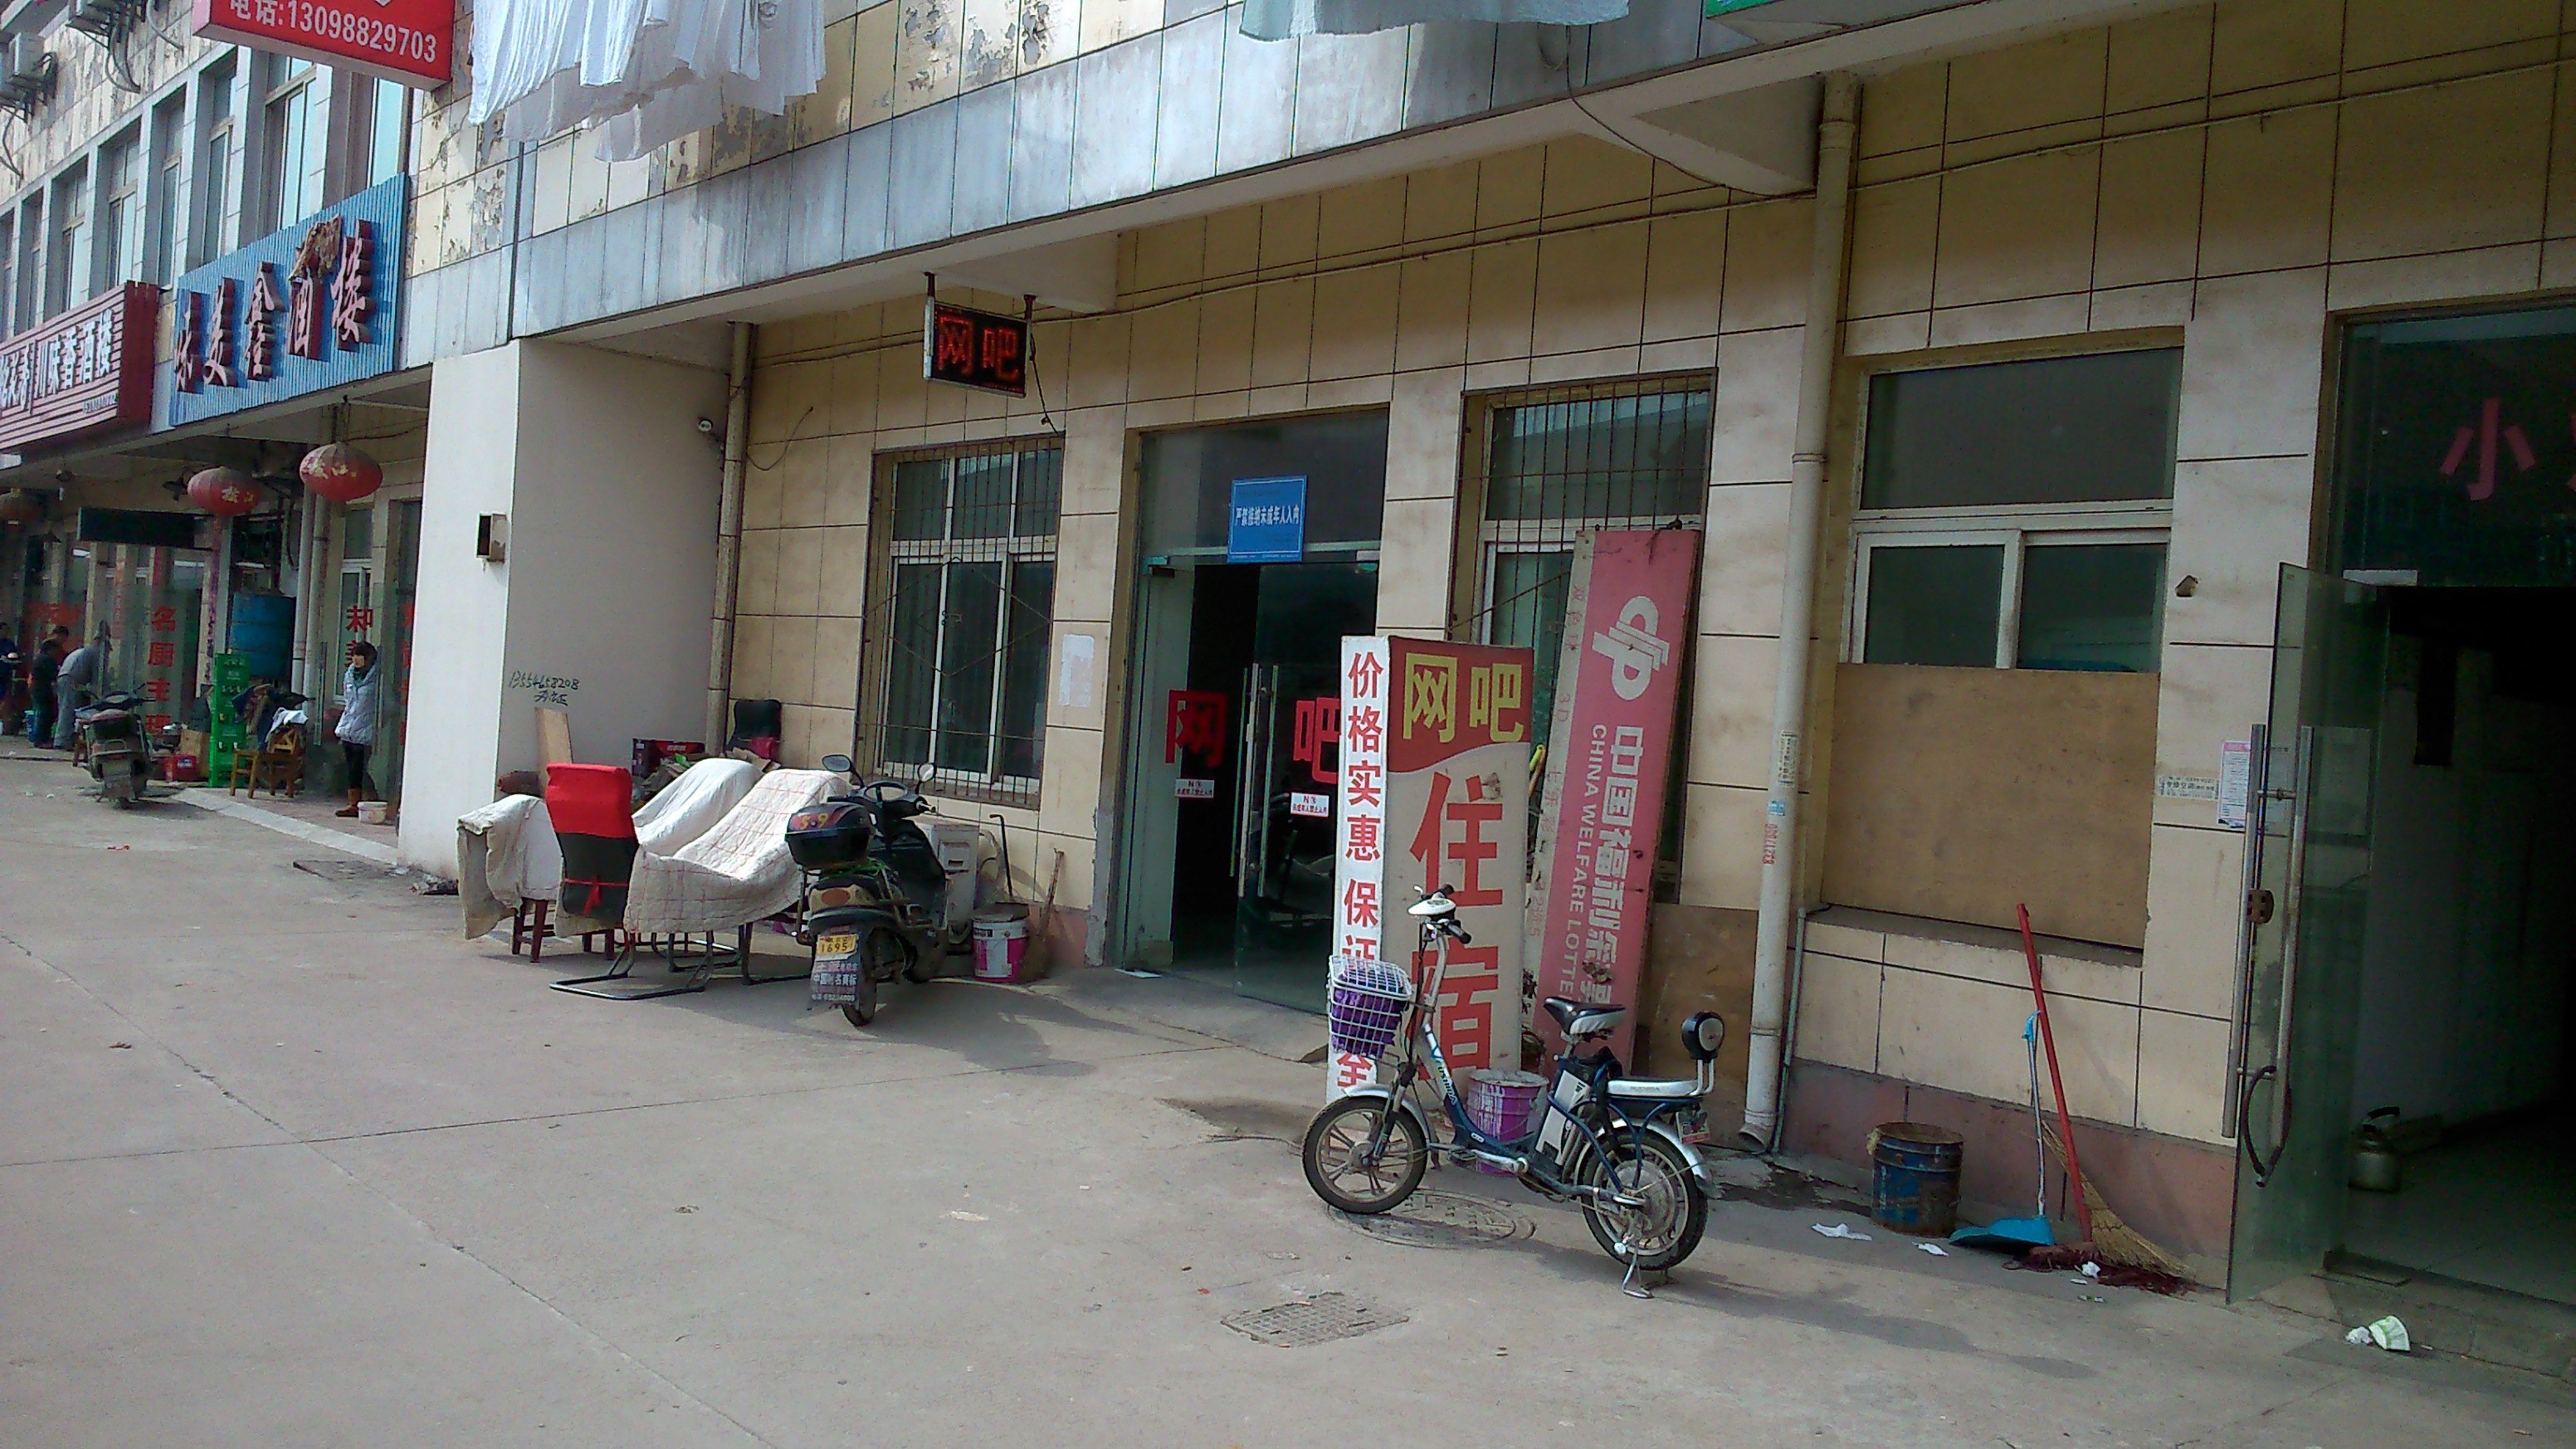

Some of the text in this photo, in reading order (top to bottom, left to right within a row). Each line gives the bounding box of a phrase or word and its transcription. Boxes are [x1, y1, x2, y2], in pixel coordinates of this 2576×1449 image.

[937, 315, 1020, 381] 网吧
[2438, 396, 2576, 501] 小
[1402, 651, 1525, 744] 网吧
[1335, 651, 1384, 1093] 价格实惠 保证全
[1559, 724, 1608, 999] CHINA WELFARE LOTTE
